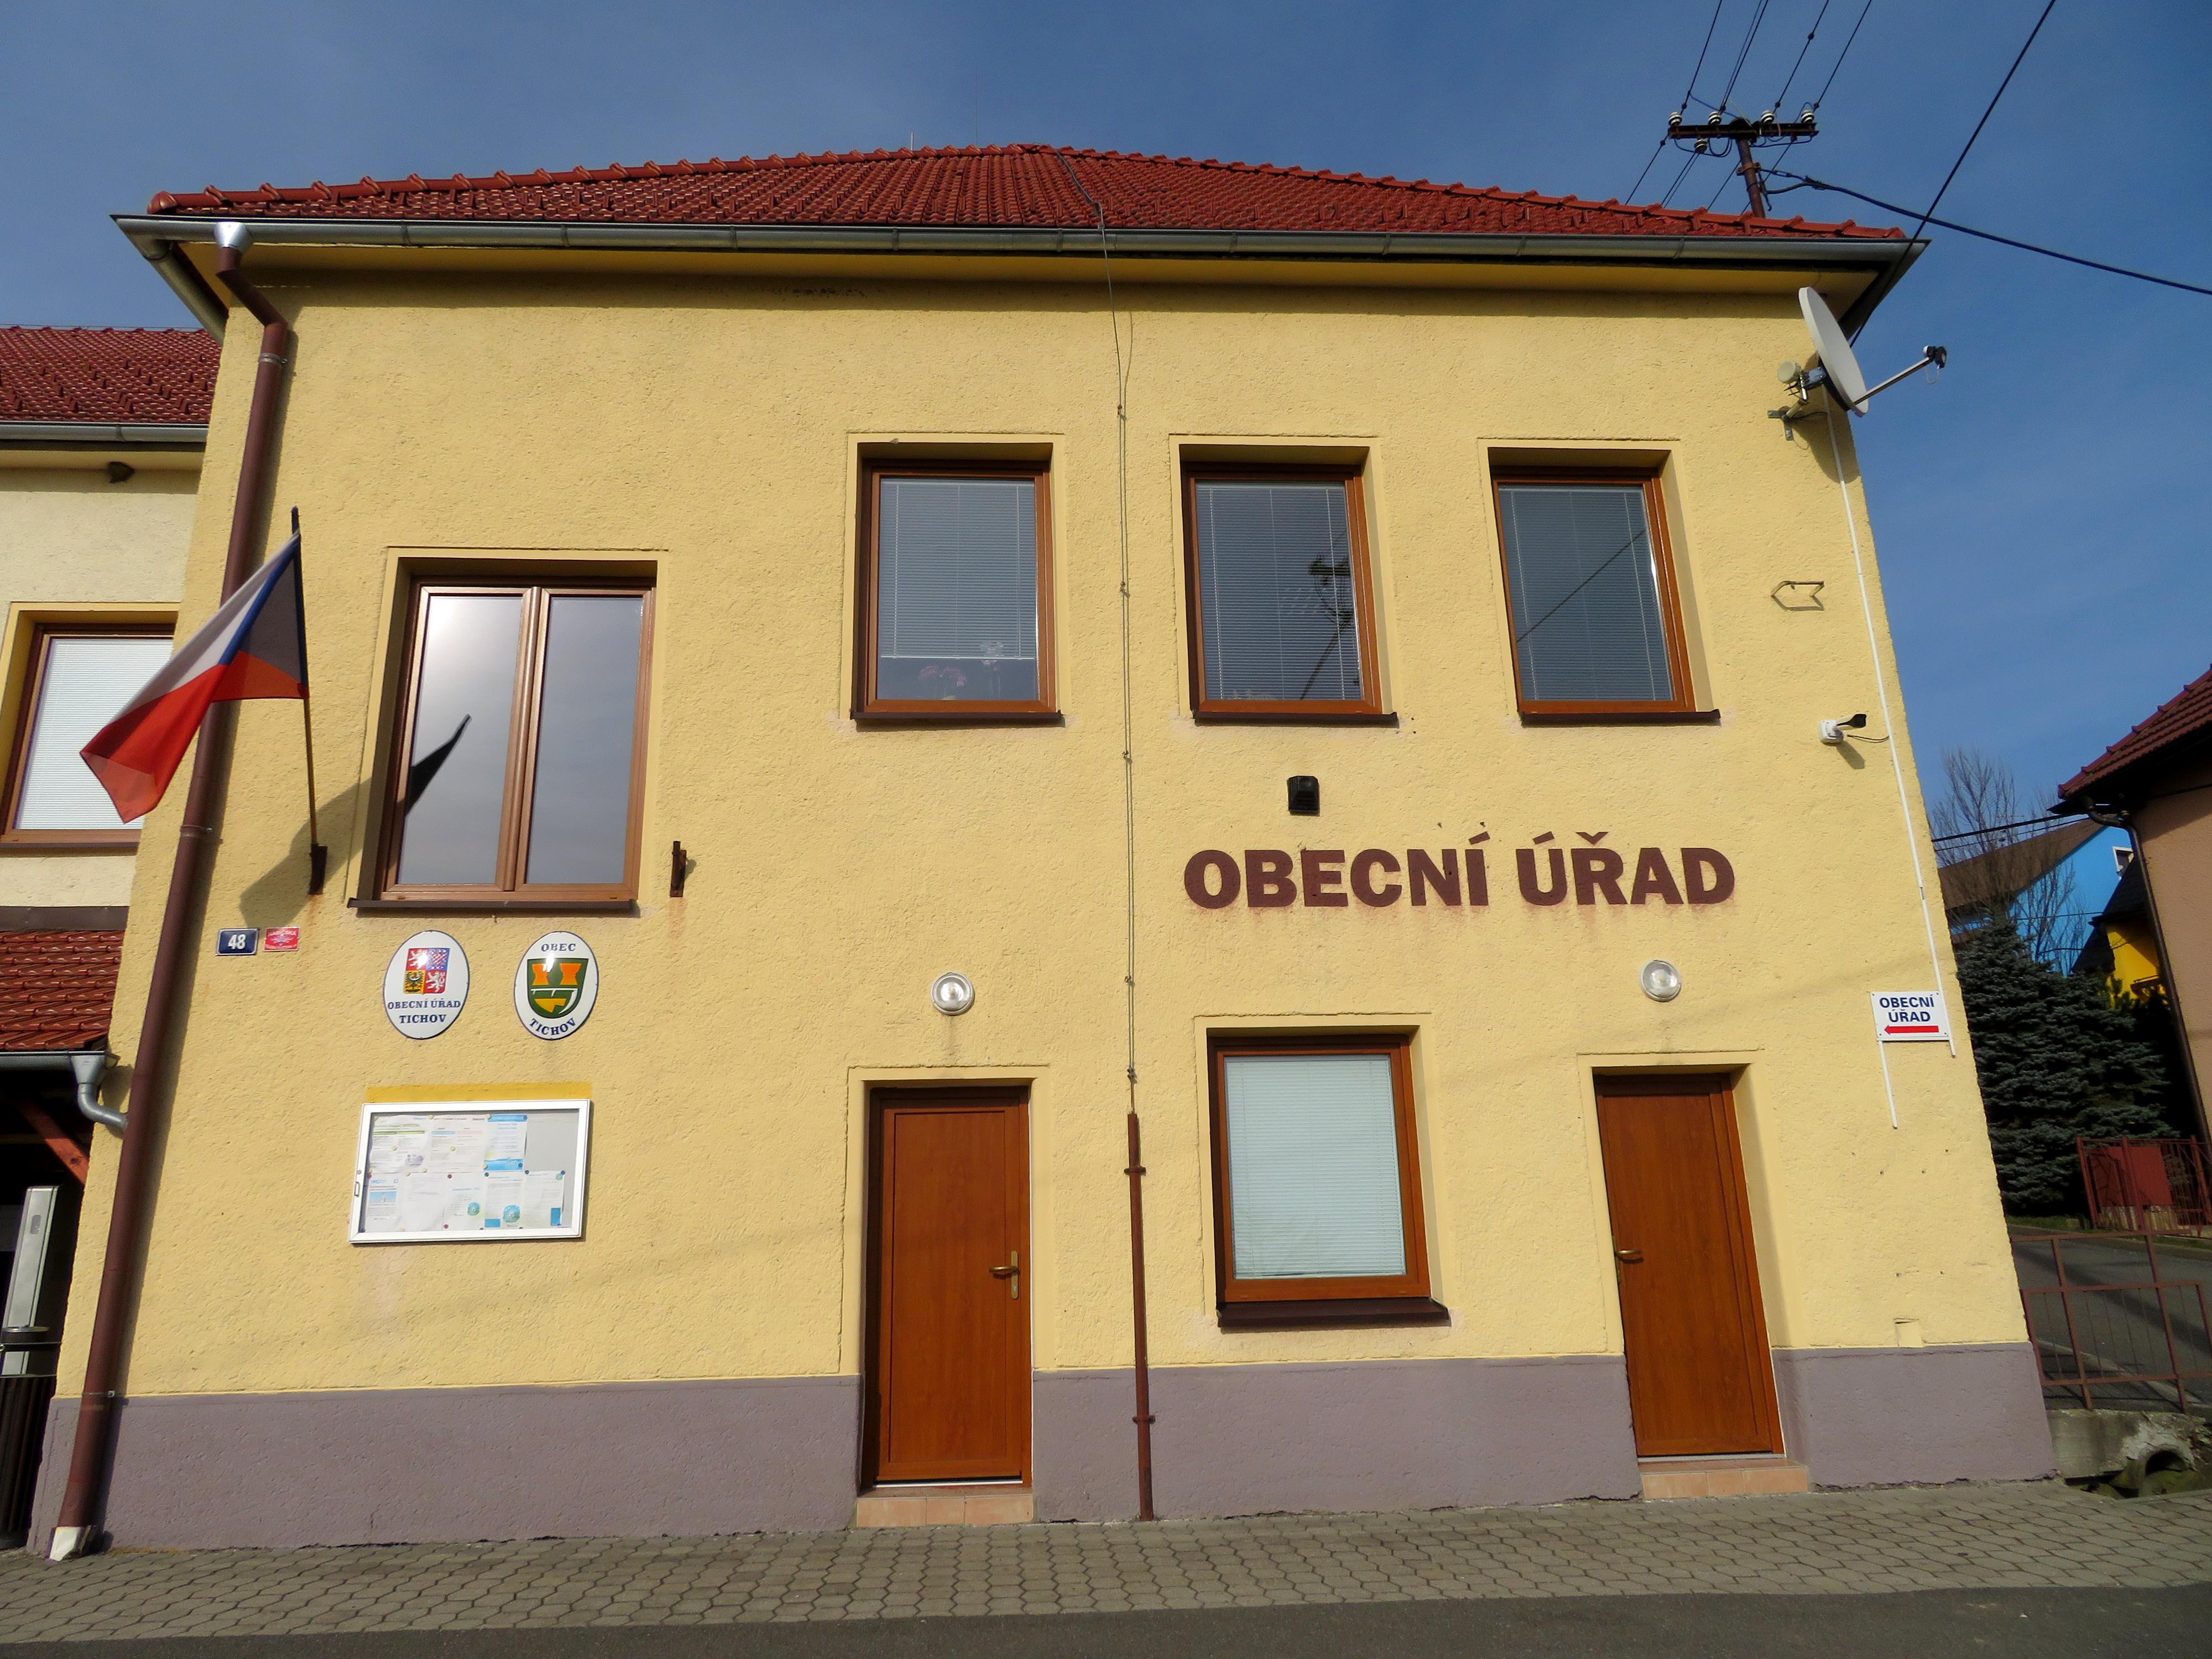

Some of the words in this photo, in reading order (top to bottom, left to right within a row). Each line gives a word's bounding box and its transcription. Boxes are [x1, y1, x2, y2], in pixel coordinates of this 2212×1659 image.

[1184, 831, 1490, 909] OBECNÍ
[1517, 831, 1735, 905] ÚŘAD
[228, 934, 246, 950] 48
[541, 943, 576, 952] OBEC
[388, 998, 428, 1009] OBECNÍ
[431, 998, 461, 1008] ÚŘAD
[1880, 994, 1934, 1008] OBECNÍ
[399, 1014, 447, 1024] TICHOV
[1888, 1009, 1931, 1022] ÚŘAD
[529, 1018, 576, 1035] TICHOV
